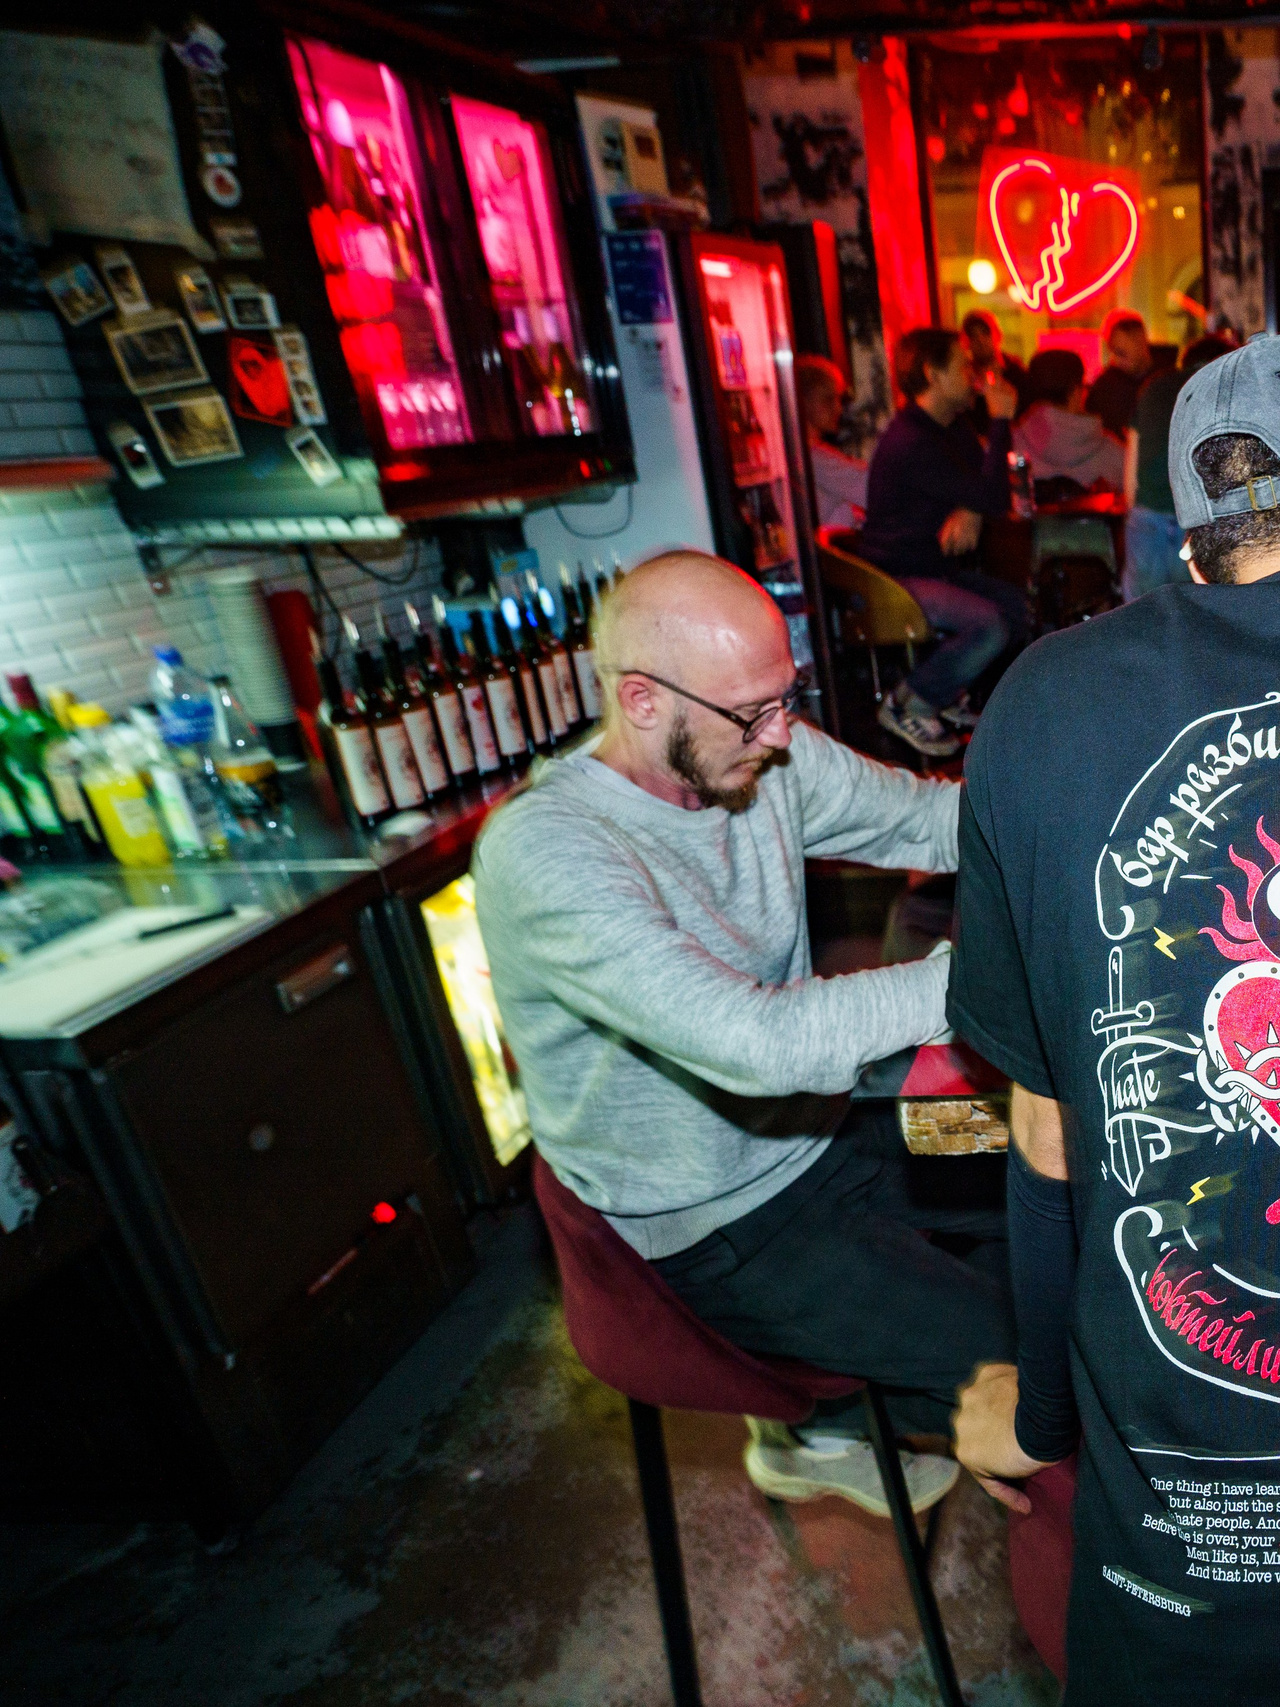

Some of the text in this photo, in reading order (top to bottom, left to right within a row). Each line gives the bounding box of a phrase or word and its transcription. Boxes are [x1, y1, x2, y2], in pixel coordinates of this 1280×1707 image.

[1109, 816, 1189, 887] бар
[1111, 1048, 1169, 1111] hate
[1150, 1477, 1173, 1491] One
[1176, 1480, 1211, 1496] thing
[1214, 1483, 1219, 1494] I
[1221, 1483, 1253, 1495] have
[1169, 1495, 1192, 1509] but
[1193, 1498, 1221, 1512] also
[1222, 1501, 1250, 1514] just
[1252, 1500, 1274, 1513] the
[1141, 1513, 1178, 1536] Before
[1192, 1531, 1204, 1544] is
[1206, 1533, 1239, 1548] over,
[1241, 1536, 1275, 1550] your
[1174, 1512, 1203, 1526] hate
[1205, 1516, 1253, 1532] people.
[1186, 1546, 1210, 1562] Men
[1212, 1549, 1237, 1563] like
[1240, 1553, 1260, 1567] us,
[1186, 1562, 1210, 1579] And
[1212, 1568, 1241, 1583] that
[1243, 1569, 1272, 1583] love
[1102, 1565, 1192, 1617] SAINT-PETERSBURG
